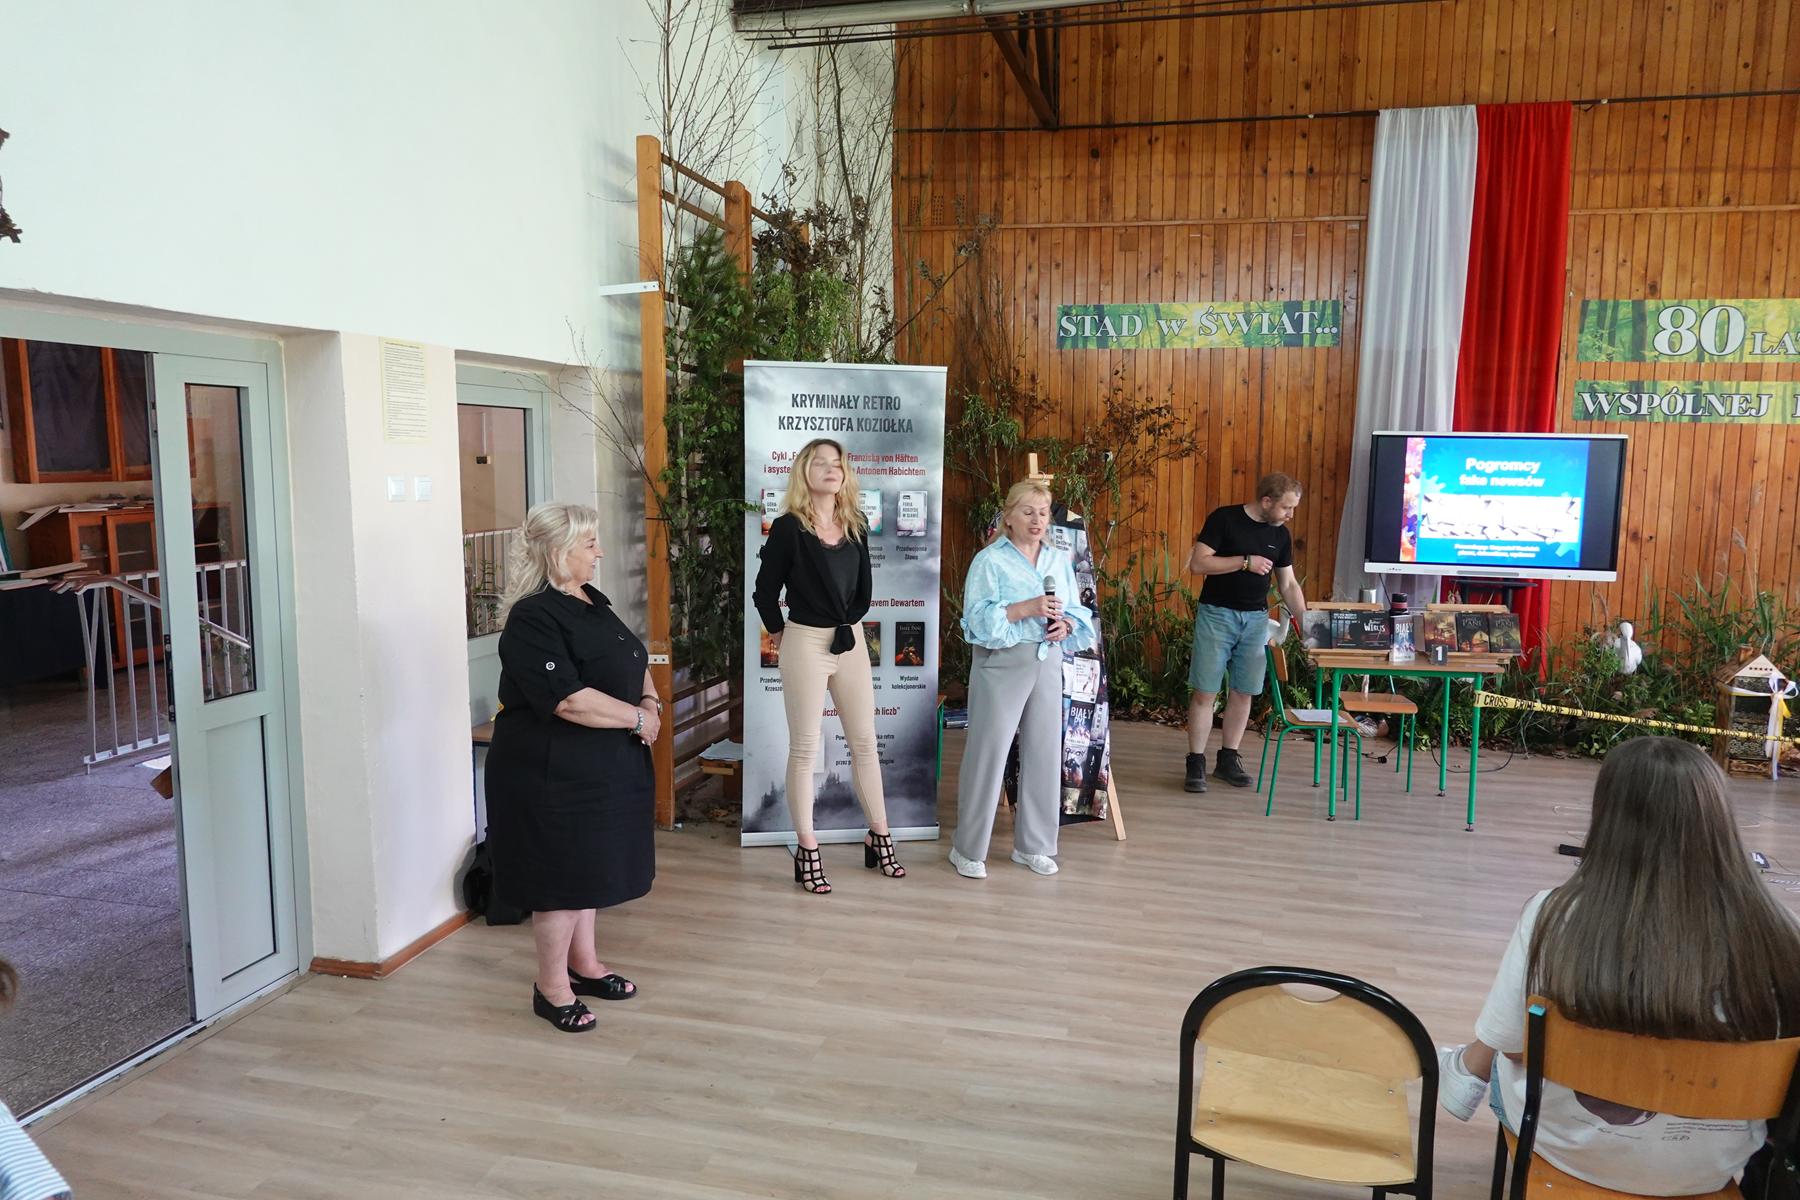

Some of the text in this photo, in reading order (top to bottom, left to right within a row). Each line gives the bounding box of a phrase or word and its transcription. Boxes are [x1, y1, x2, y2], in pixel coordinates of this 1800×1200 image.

[1058, 305, 1339, 343] STĄD w ŚWIAT...
[1653, 304, 1746, 357] 80
[791, 393, 901, 411] KRYMINAŁY RETRO
[1578, 386, 1774, 418] WSPÓLNEJ
[778, 415, 914, 434] KRZYSZTOFA KOZIOŁKA
[771, 450, 788, 462] Cykl
[882, 454, 894, 463] von
[767, 465, 791, 476] asyste
[888, 466, 926, 477] Habichtem
[1465, 457, 1541, 475] Pogromcy
[869, 598, 925, 607] avem Dewartem
[1435, 645, 1443, 662] 1
[891, 683, 926, 691] kolekcjonerskie
[1484, 694, 1509, 708] CROSS
[1070, 705, 1093, 721] BIAŁY
